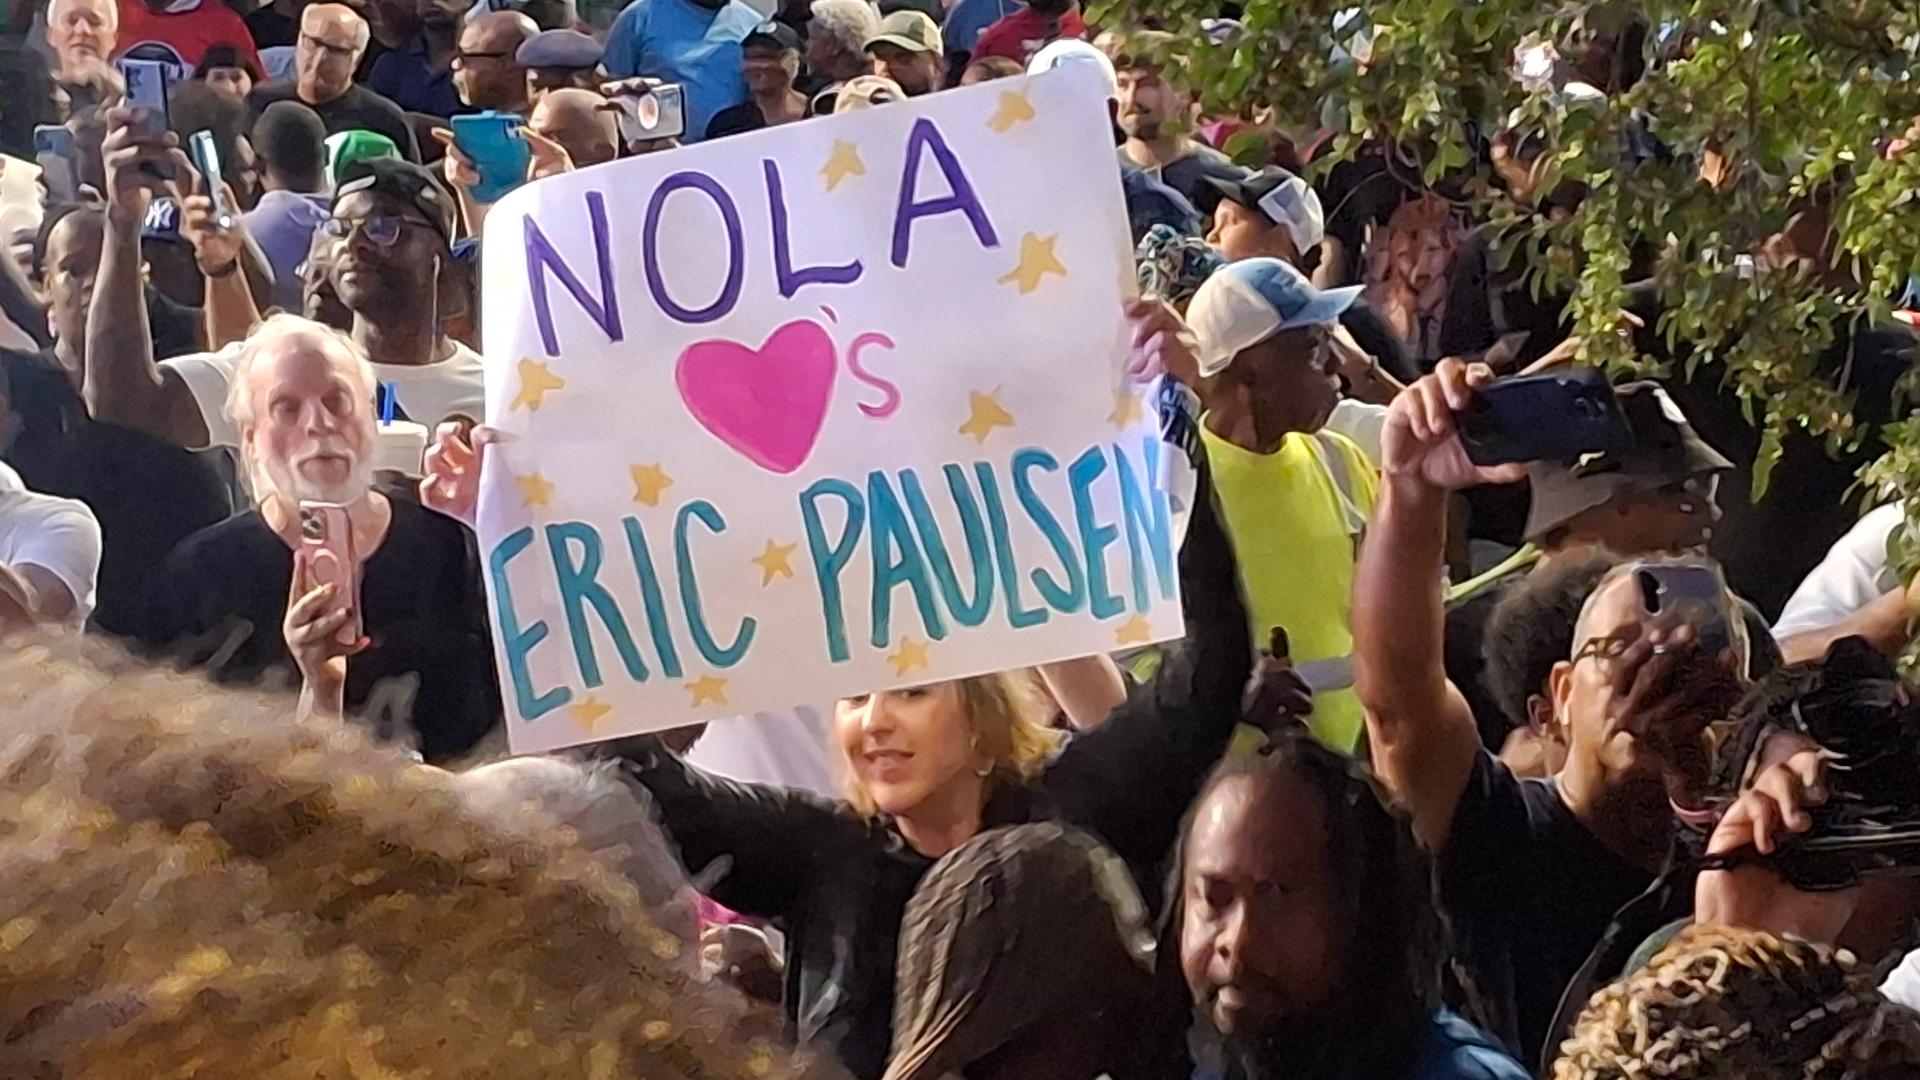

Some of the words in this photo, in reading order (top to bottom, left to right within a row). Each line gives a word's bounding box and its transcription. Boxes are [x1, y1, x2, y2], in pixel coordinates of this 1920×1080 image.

[526, 118, 999, 354] NOLA
[490, 499, 755, 719] ERIC
[799, 436, 1176, 661] PAULSEN
